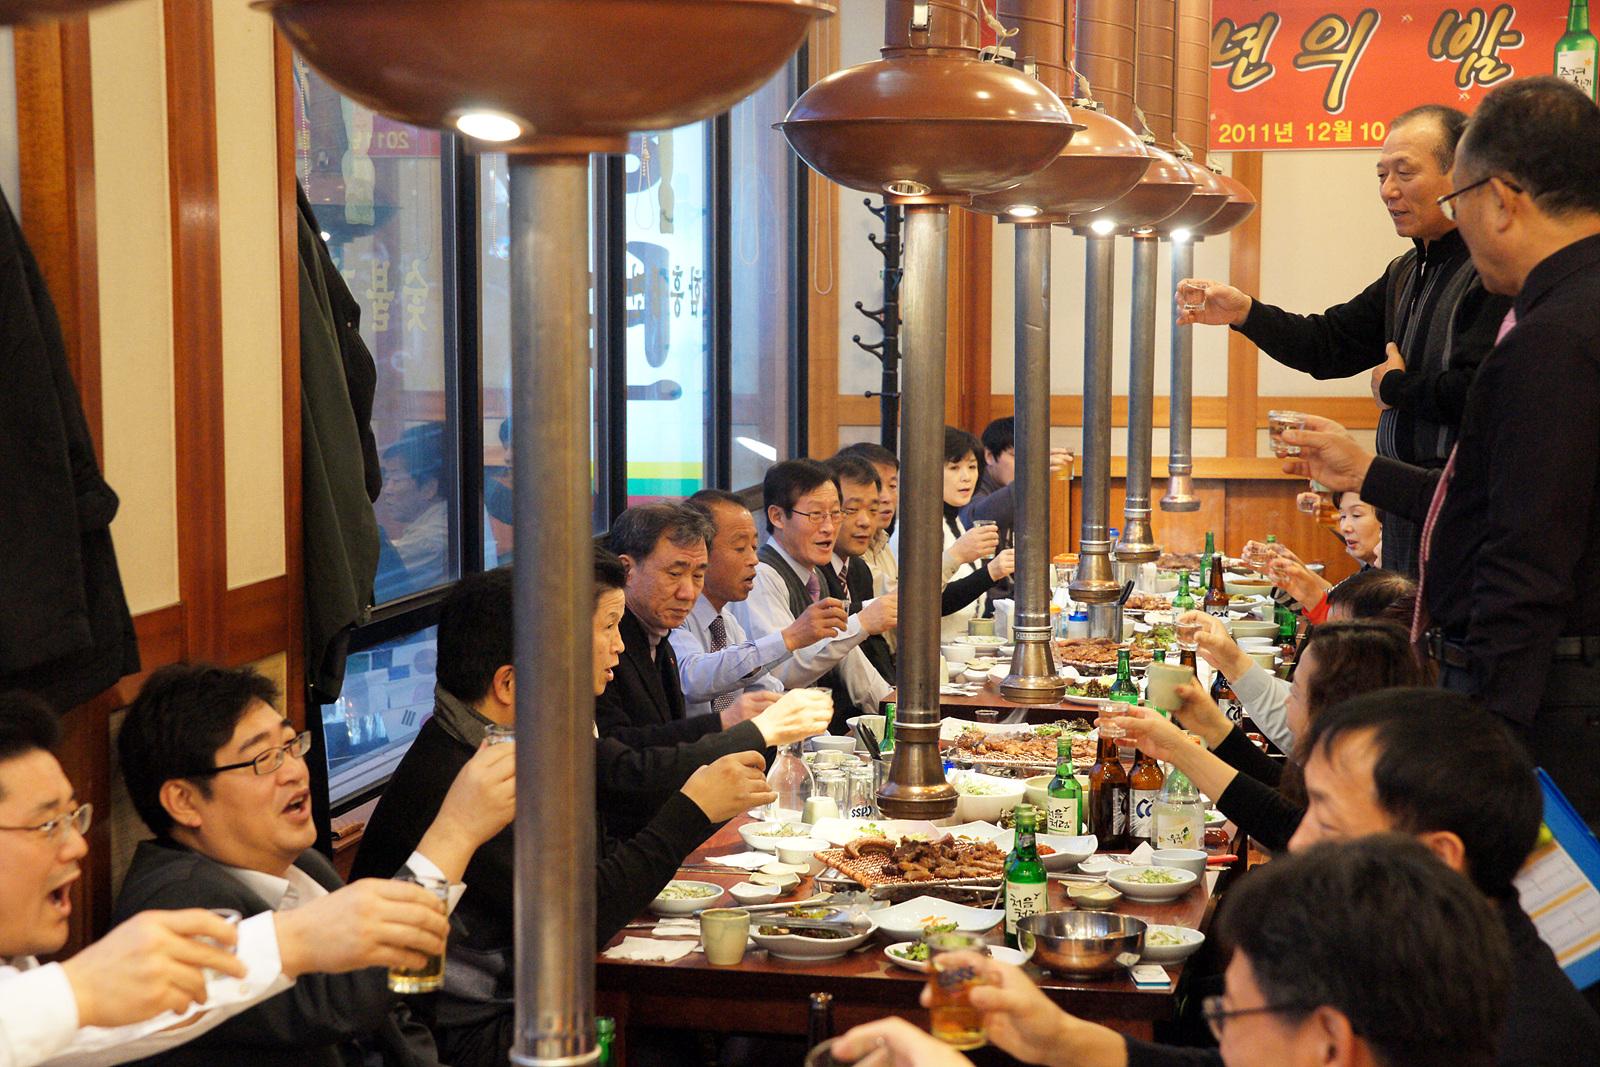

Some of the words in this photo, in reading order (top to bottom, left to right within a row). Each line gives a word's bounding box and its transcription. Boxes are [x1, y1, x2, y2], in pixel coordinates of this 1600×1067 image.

[1427, 3, 1525, 91] 밤
[1218, 121, 1293, 143] 2011년
[1305, 119, 1352, 142] 12월
[1010, 893, 1034, 908] 처음
